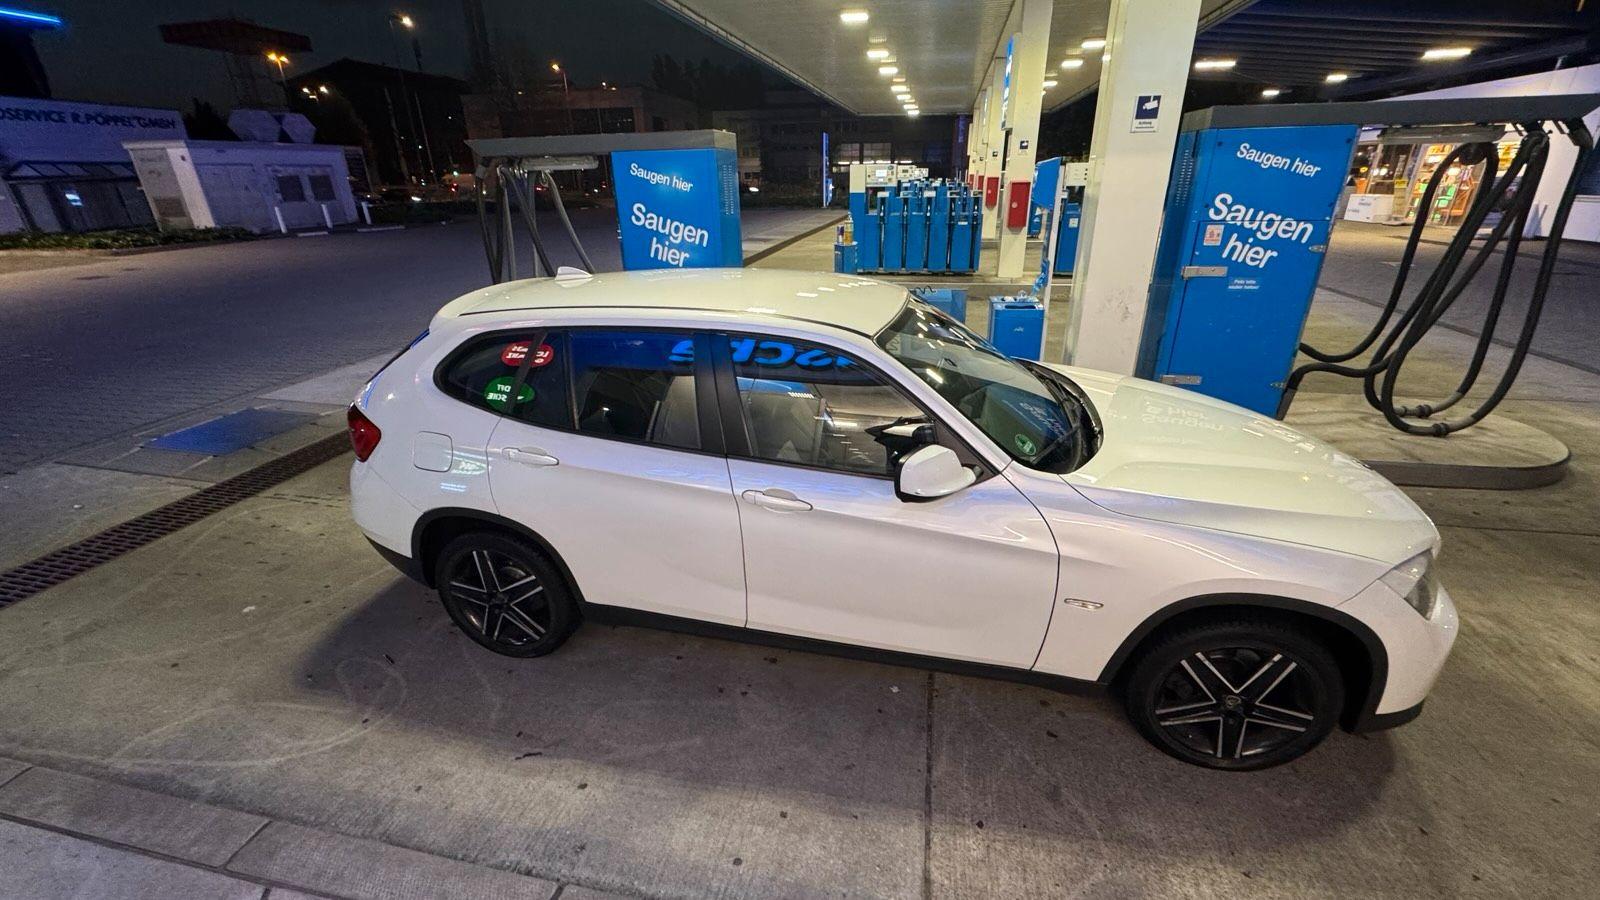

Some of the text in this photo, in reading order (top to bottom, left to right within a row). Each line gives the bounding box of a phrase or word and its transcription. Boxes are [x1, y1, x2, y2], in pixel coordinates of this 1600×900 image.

[629, 163, 694, 192] Saugen hier
[1236, 143, 1321, 178] Saugen hier
[631, 203, 709, 248] Saugen
[1208, 193, 1314, 244] Saugen
[650, 237, 690, 267] hier
[1221, 233, 1278, 268] hier
